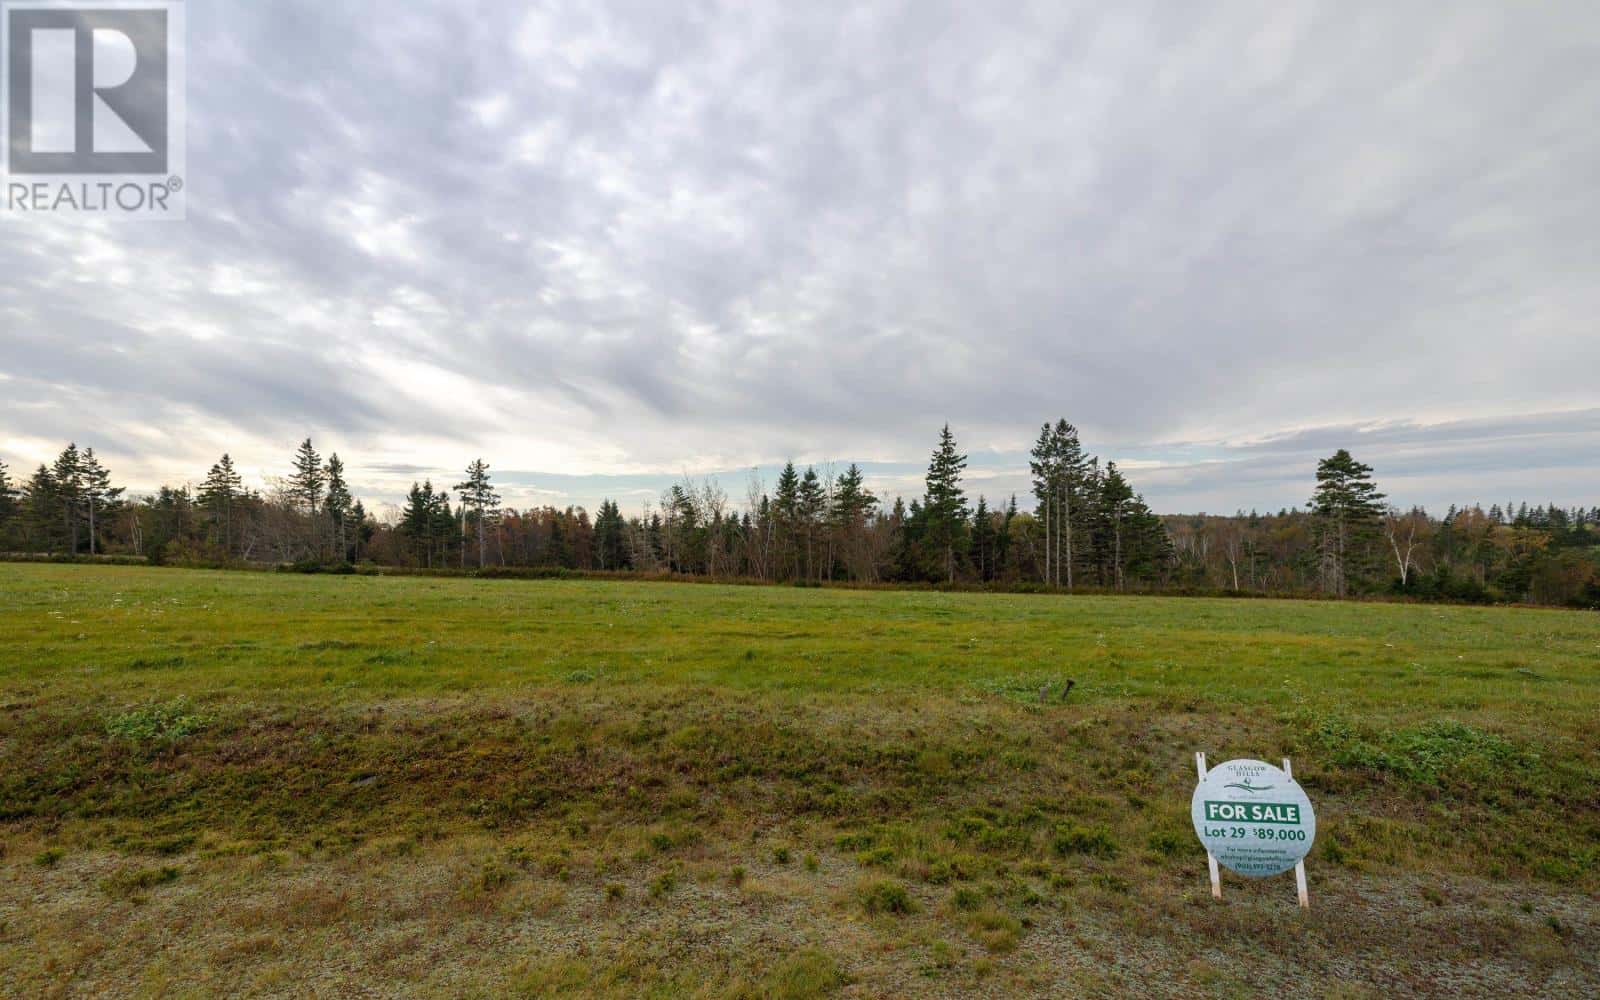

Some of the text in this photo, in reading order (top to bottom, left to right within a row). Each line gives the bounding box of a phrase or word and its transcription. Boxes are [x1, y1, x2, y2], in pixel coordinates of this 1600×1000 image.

[1210, 804, 1297, 821] FOR SALE
[1204, 826, 1306, 842] Lot 29 $89,000
